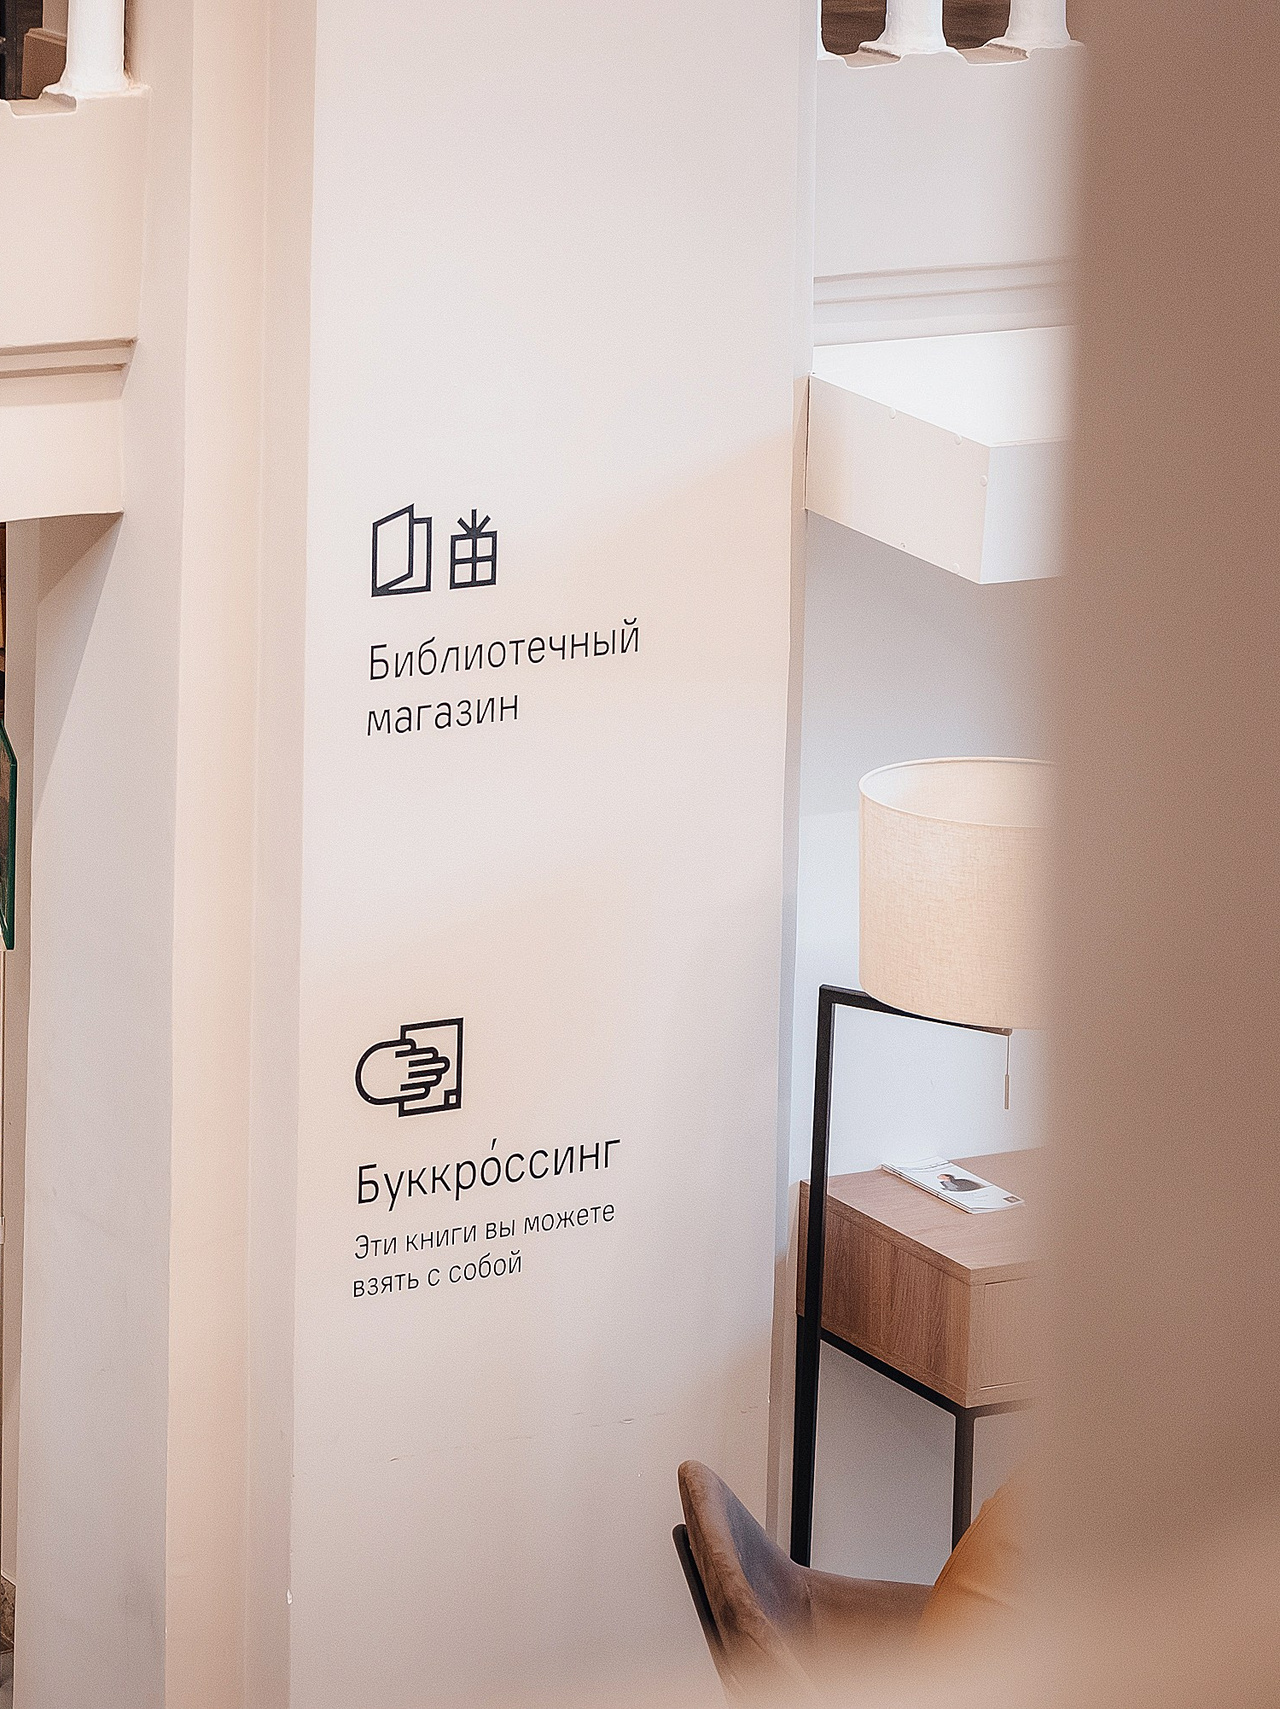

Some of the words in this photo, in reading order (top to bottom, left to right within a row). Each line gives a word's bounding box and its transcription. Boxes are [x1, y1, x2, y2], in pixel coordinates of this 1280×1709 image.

[370, 617, 639, 680] Библиотечный
[367, 695, 518, 736] магазин
[355, 1234, 397, 1259] Эти
[406, 1224, 477, 1253] книги
[486, 1219, 515, 1240] вы
[524, 1203, 615, 1234] можете
[353, 1272, 420, 1298] взять
[427, 1268, 441, 1287] с
[449, 1249, 522, 1284] собой
